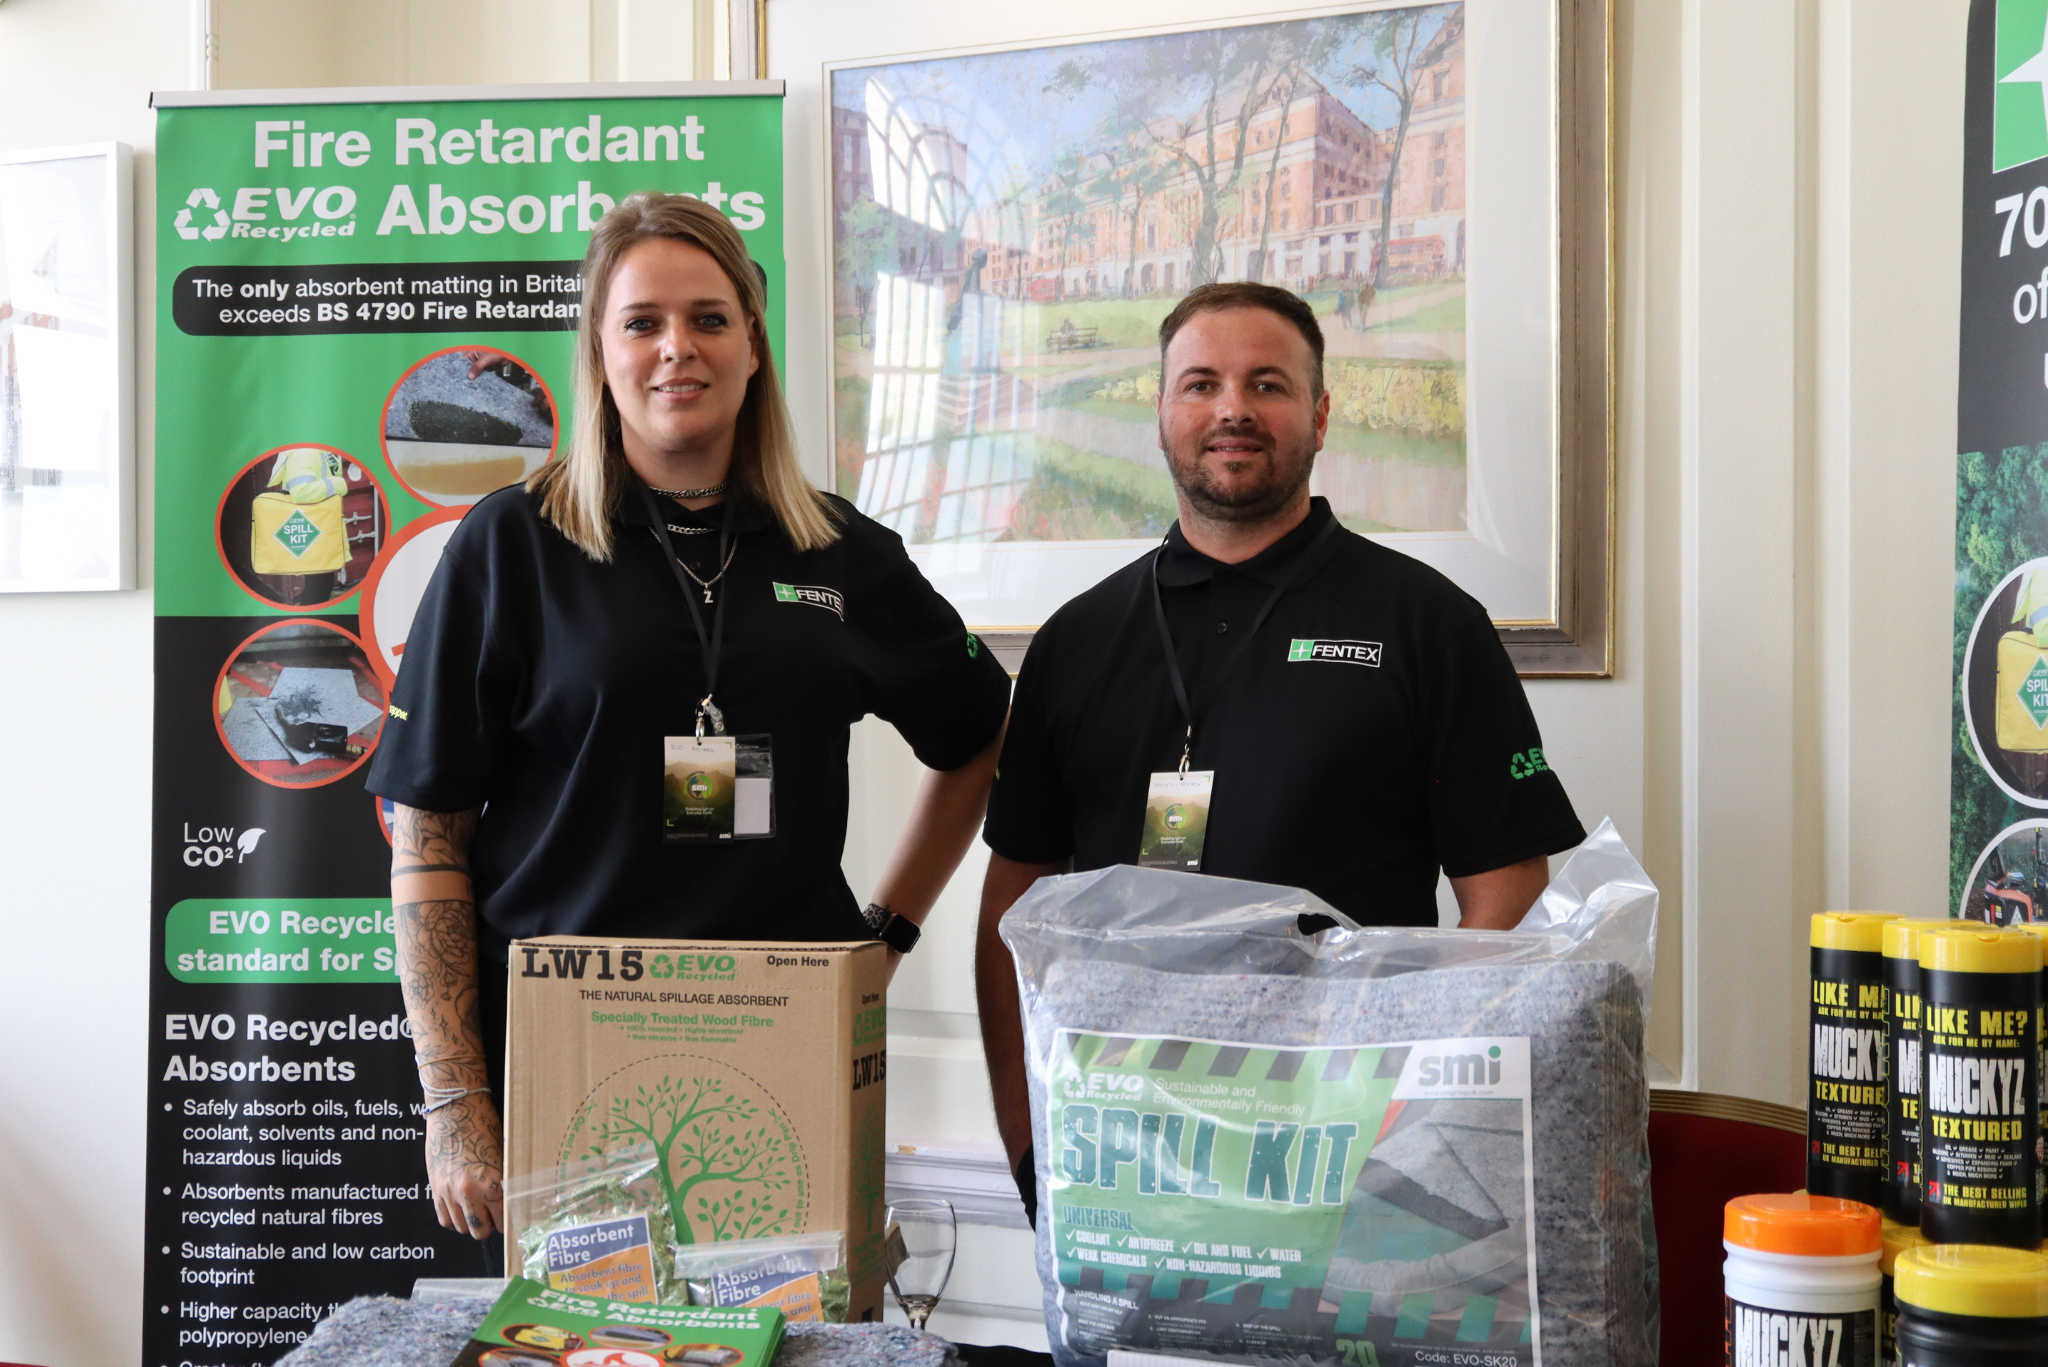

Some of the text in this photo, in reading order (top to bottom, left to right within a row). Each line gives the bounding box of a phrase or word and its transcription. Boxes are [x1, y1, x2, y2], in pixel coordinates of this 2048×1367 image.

[254, 115, 705, 168] Fire Retardant
[231, 185, 357, 221] EVO
[376, 180, 765, 236] Absorbts
[231, 220, 356, 243] Recycled
[192, 279, 233, 298] The
[239, 279, 290, 301] only
[295, 276, 404, 296] absorbent
[411, 275, 493, 298] matting
[500, 276, 518, 294] in
[219, 300, 582, 323] exceeds BS 4790 Fire Retardan
[284, 524, 314, 534] SPILL
[290, 534, 308, 544] KIT
[704, 590, 714, 604] Z
[796, 589, 843, 612] FENTE
[1312, 645, 1379, 662] FENTEX
[183, 822, 234, 844] Low
[209, 910, 395, 939] EVO Recycle
[177, 946, 364, 972] standard for
[521, 947, 829, 981] LW15 EVO Open Here
[676, 971, 736, 982] Recycled
[580, 990, 788, 1007] THE NATURAL SPILLAGE ABSORBENT
[1813, 980, 1849, 1007] LIKE
[591, 1011, 774, 1027] Specially Treated Wood Fibre
[1818, 1006, 1870, 1019] ASK FOR ME BY
[1926, 1006, 1969, 1035] LIKE
[1980, 1010, 2028, 1036] ME?
[165, 1014, 236, 1040] EVO
[1903, 1021, 1917, 1030] ASK
[1813, 1023, 1884, 1082] MUCKY
[1933, 1035, 2020, 1048] ASK FOR ME BY NAME:
[163, 1055, 356, 1083] Absorbents
[853, 1049, 886, 1091] LW15
[1418, 1045, 1502, 1088] smi
[1087, 1073, 1256, 1098] EVO Sustainable and
[1815, 1080, 1885, 1106] TEXTURE
[1929, 1053, 2026, 1116] MUCKYZ
[183, 1098, 403, 1120] Safely absorb oils, fuels,
[1086, 1090, 1306, 1116] Recycled Environmentally Friendly
[182, 1124, 424, 1143] coolant, solvents and non-
[1931, 1115, 2023, 1142] TEXTURED
[182, 1148, 343, 1169] hazardous liquids
[1061, 1103, 1358, 1207] SPILL KIT
[1823, 1142, 1860, 1157] THE BEST
[1823, 1154, 1878, 1167] UK MANUFACTURED
[181, 1183, 419, 1200] Absorbents manufactured
[1943, 1184, 2027, 1199] THE BEST SELLING
[1943, 1196, 2027, 1209] UK MANUFACTURED WIPES
[181, 1208, 383, 1228] recycled natural fibres
[1063, 1205, 1134, 1231] UNIVERSAL
[547, 1224, 634, 1252] Absorbent
[1076, 1230, 1301, 1263] COOLANT ANTIFREEZE OIL AND FUEL WATER
[181, 1242, 435, 1260] Sustainable and low carbon
[548, 1250, 591, 1267] Fibre
[560, 1263, 643, 1283] Absorbent fibre
[717, 1256, 801, 1289] Absorbent
[1077, 1248, 1281, 1279] WEAK CHEMICALS NON-HAZARDOUS LIQUIDS
[180, 1268, 255, 1287] footprint
[578, 1274, 642, 1293] soak up and
[626, 1286, 648, 1299] spill
[718, 1284, 761, 1305] Fibre
[787, 1292, 812, 1305] fibre
[1074, 1289, 1111, 1304] HANDLING
[1118, 1298, 1139, 1310] SPILL
[180, 1301, 322, 1323] Higher capacity
[540, 1289, 598, 1308] Fire
[606, 1302, 760, 1321] Retardant
[791, 1302, 811, 1316] and
[605, 1312, 761, 1329] Absorbents
[179, 1326, 308, 1348] polypropylene
[1735, 1304, 1843, 1367] MUCKYZ
[1335, 1338, 1380, 1367] 20
[1415, 1350, 1517, 1367] Code: EVO-SK20
